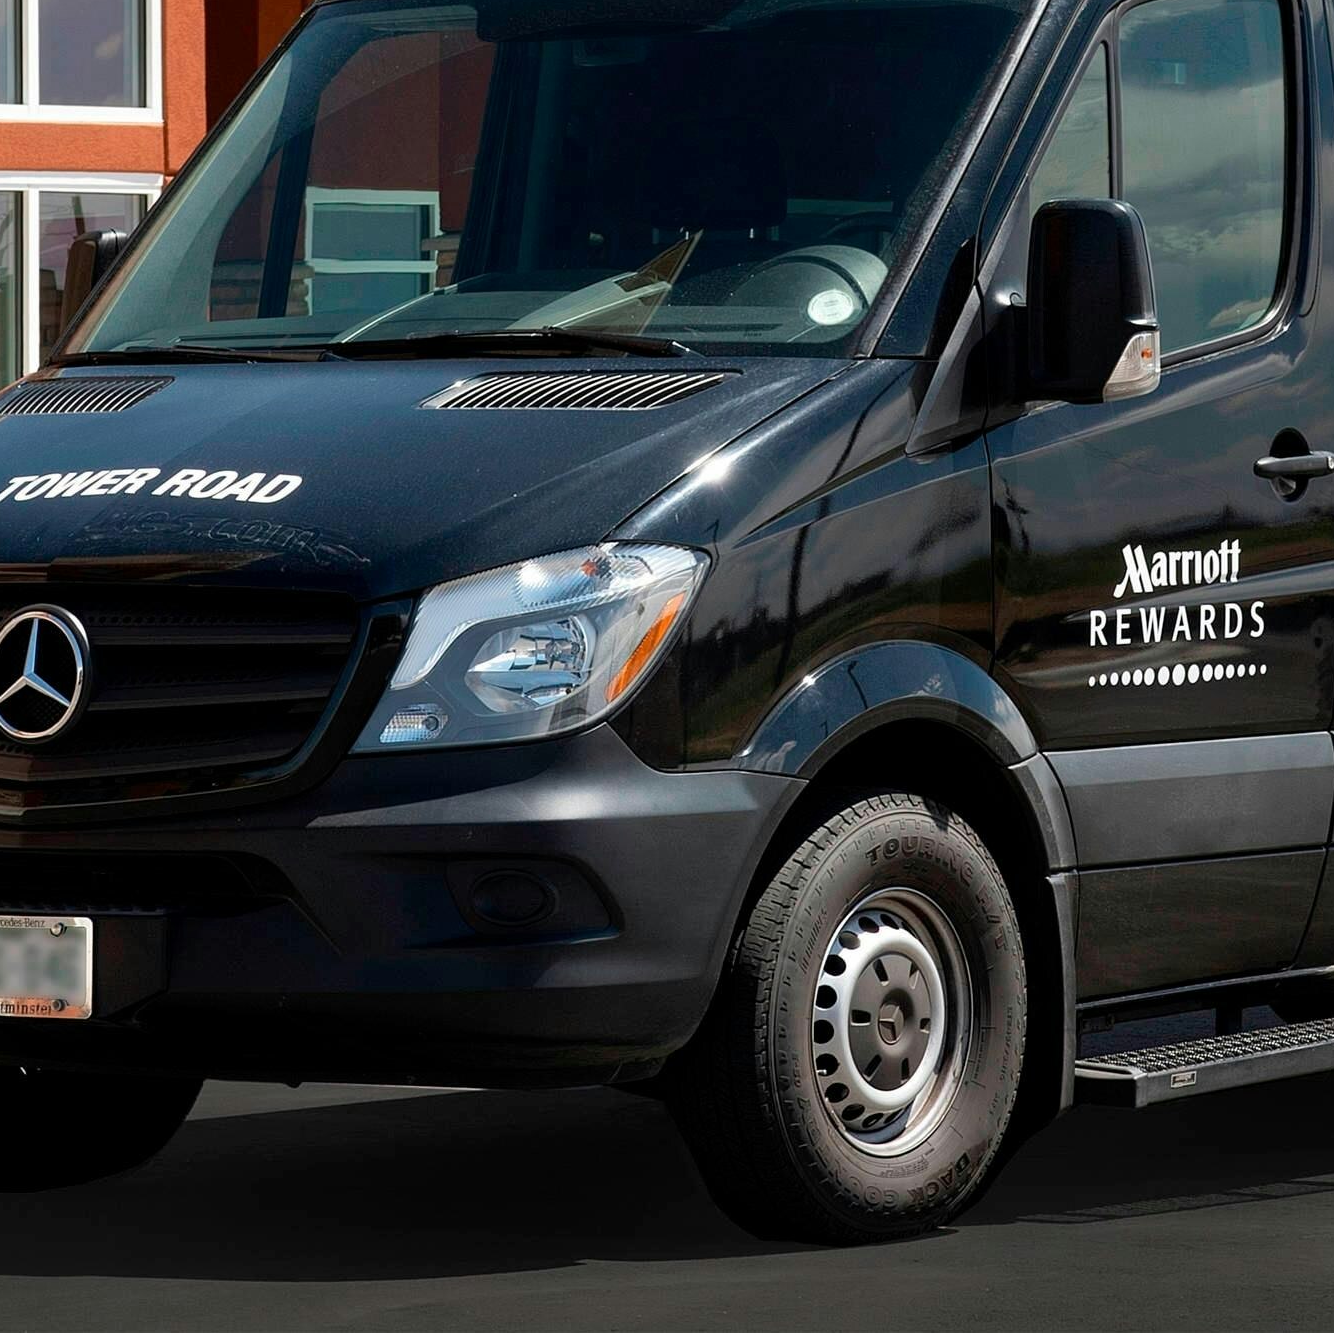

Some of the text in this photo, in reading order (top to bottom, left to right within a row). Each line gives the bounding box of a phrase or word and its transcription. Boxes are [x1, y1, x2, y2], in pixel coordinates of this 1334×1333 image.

[151, 468, 304, 505] ROAD
[1112, 538, 1243, 599] Marriott
[1088, 600, 1266, 648] REWARDS
[865, 835, 974, 887] TOURING
[907, 1151, 972, 1205] BACK
